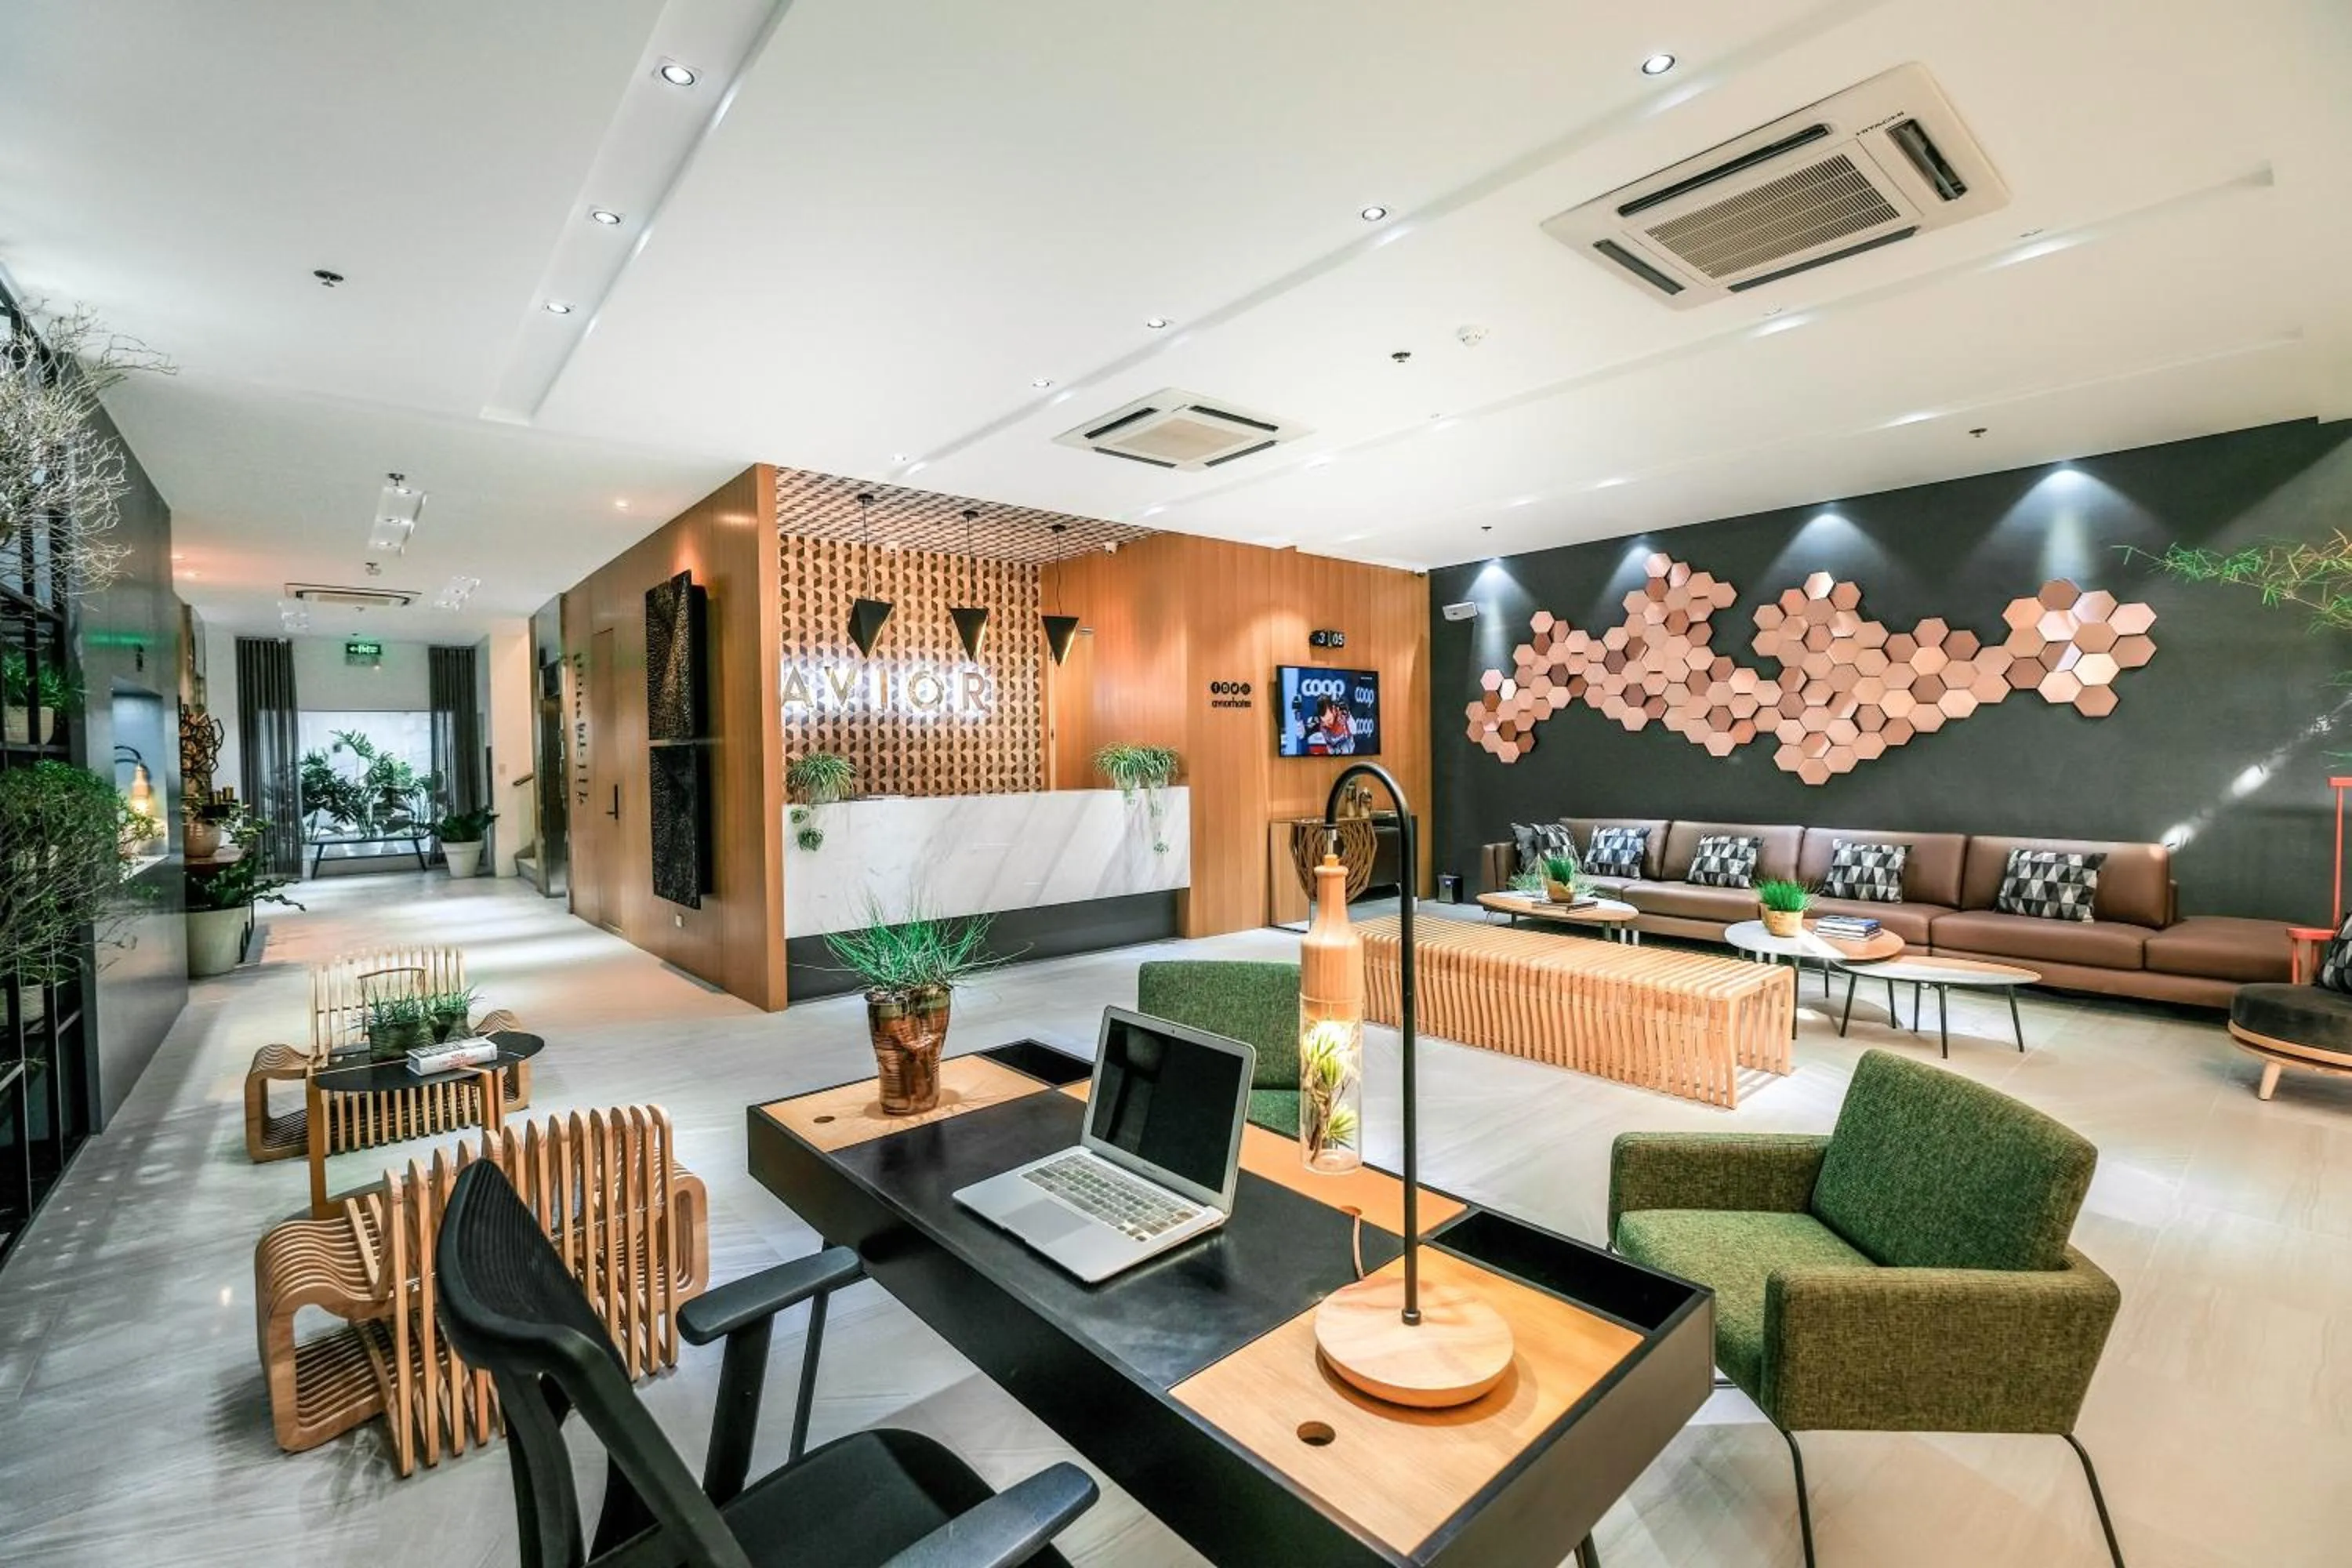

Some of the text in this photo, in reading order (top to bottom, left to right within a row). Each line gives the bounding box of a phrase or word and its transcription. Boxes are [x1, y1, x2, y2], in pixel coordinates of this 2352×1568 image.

[1332, 633, 1343, 645] 05
[782, 666, 986, 711] AVIOR
[1301, 678, 1345, 701] coop
